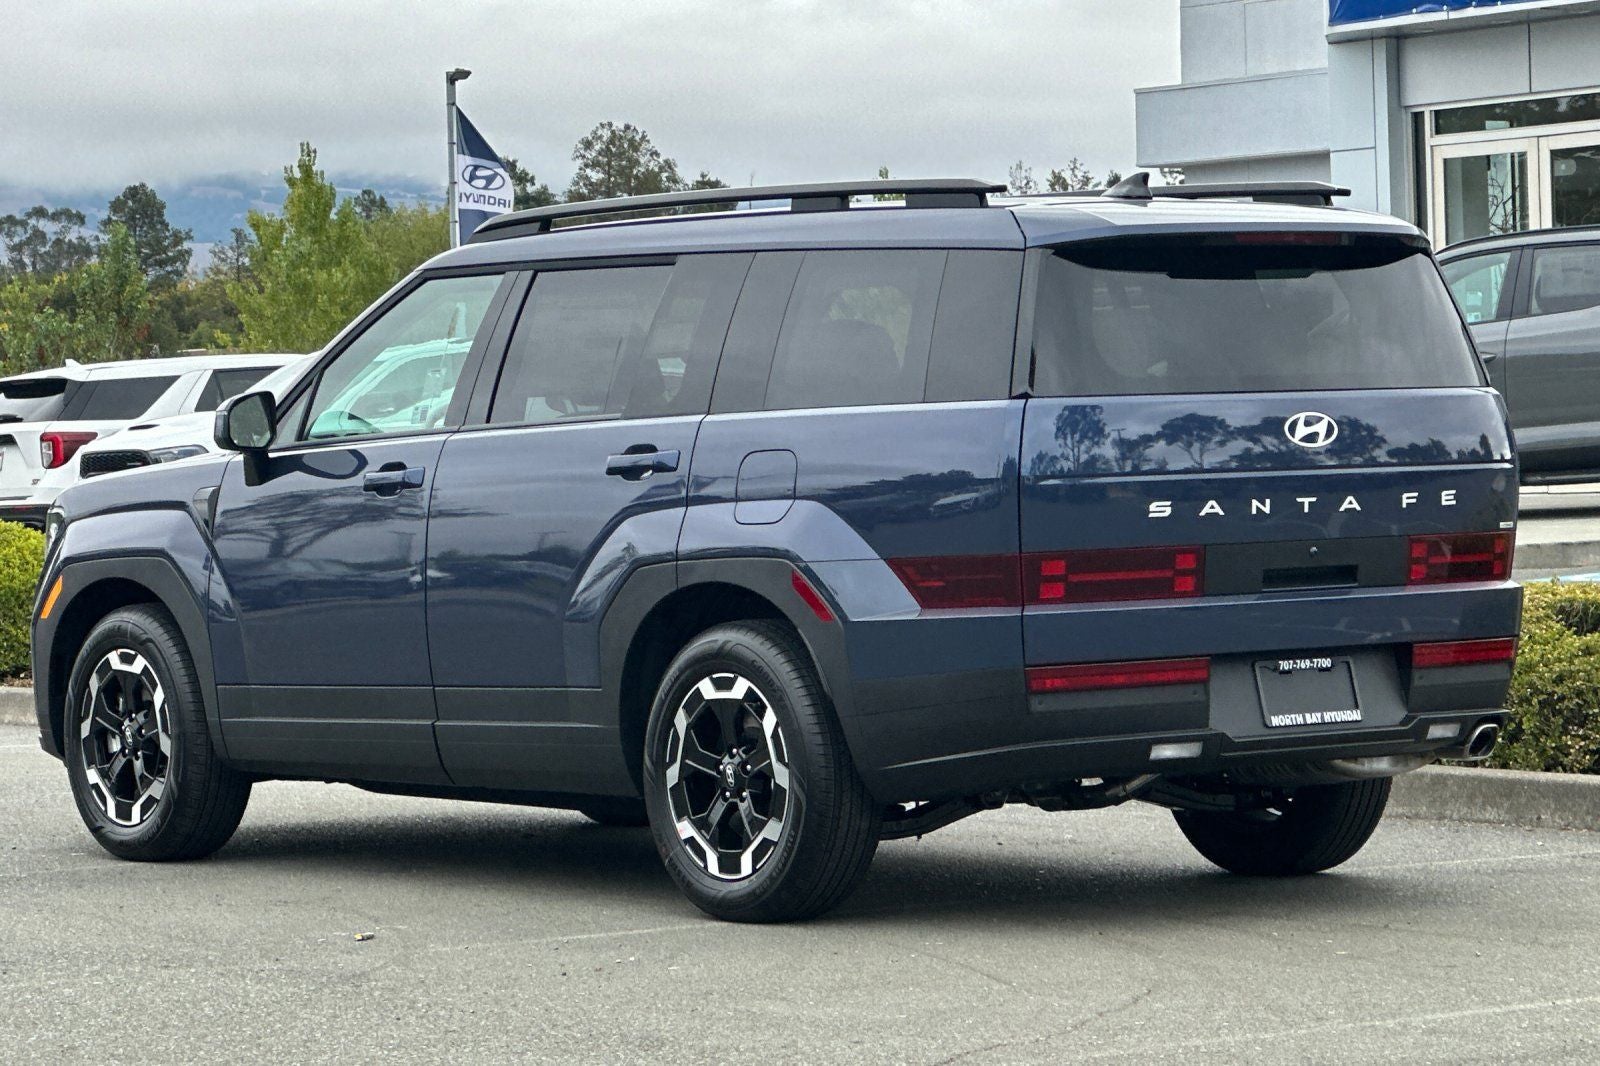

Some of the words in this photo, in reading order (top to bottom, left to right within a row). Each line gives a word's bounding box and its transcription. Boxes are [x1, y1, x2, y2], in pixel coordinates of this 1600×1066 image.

[1148, 496, 1361, 518] SANTA
[1402, 490, 1457, 508] FE
[1279, 658, 1332, 670] 707-769-7700
[1271, 713, 1304, 727] NORTH
[1305, 711, 1322, 724] BAY
[1323, 709, 1362, 723] HYUNDAI
